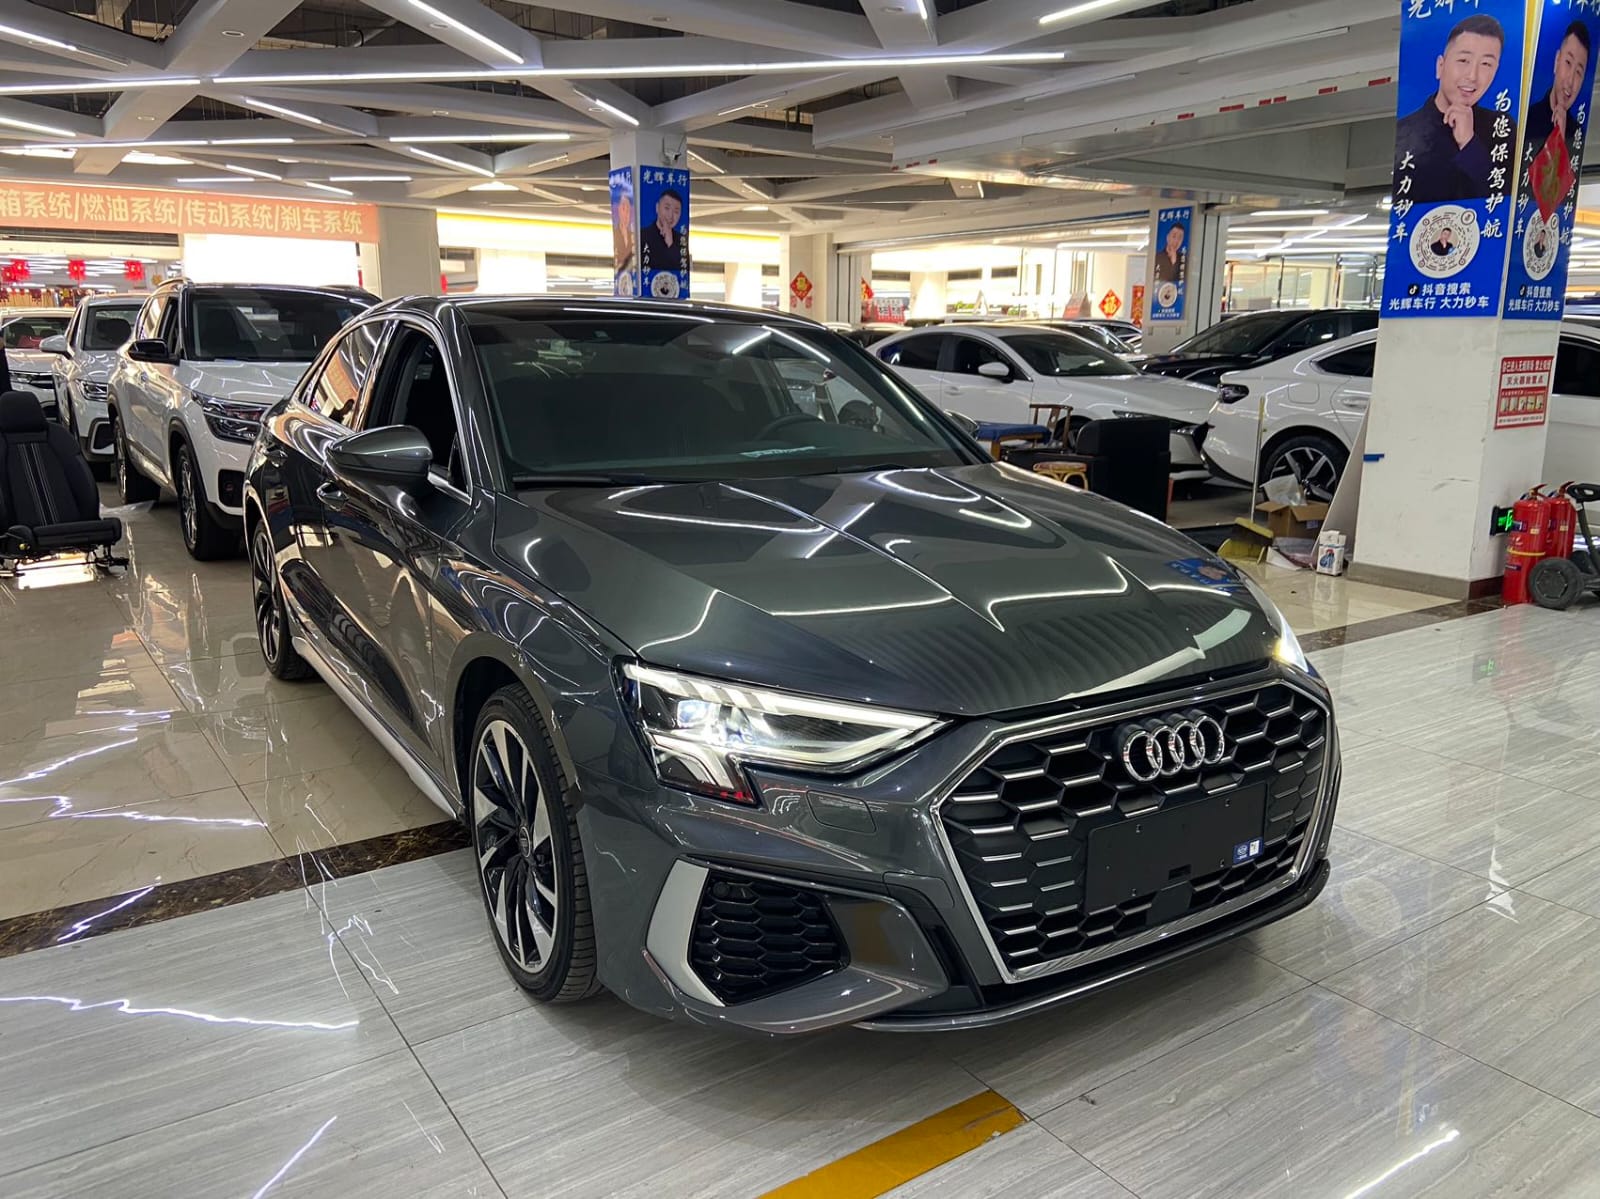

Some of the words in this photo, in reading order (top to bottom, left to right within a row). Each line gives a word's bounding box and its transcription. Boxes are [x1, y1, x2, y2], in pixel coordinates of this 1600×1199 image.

[1480, 88, 1512, 239] 为您保驾护航
[1392, 151, 1415, 243] 大力秒车
[1422, 282, 1471, 296] 抖音搜索
[1388, 297, 1436, 311] 光辉车行
[1440, 296, 1490, 309] 大力秒车
[1535, 299, 1560, 312] 大力秒车
